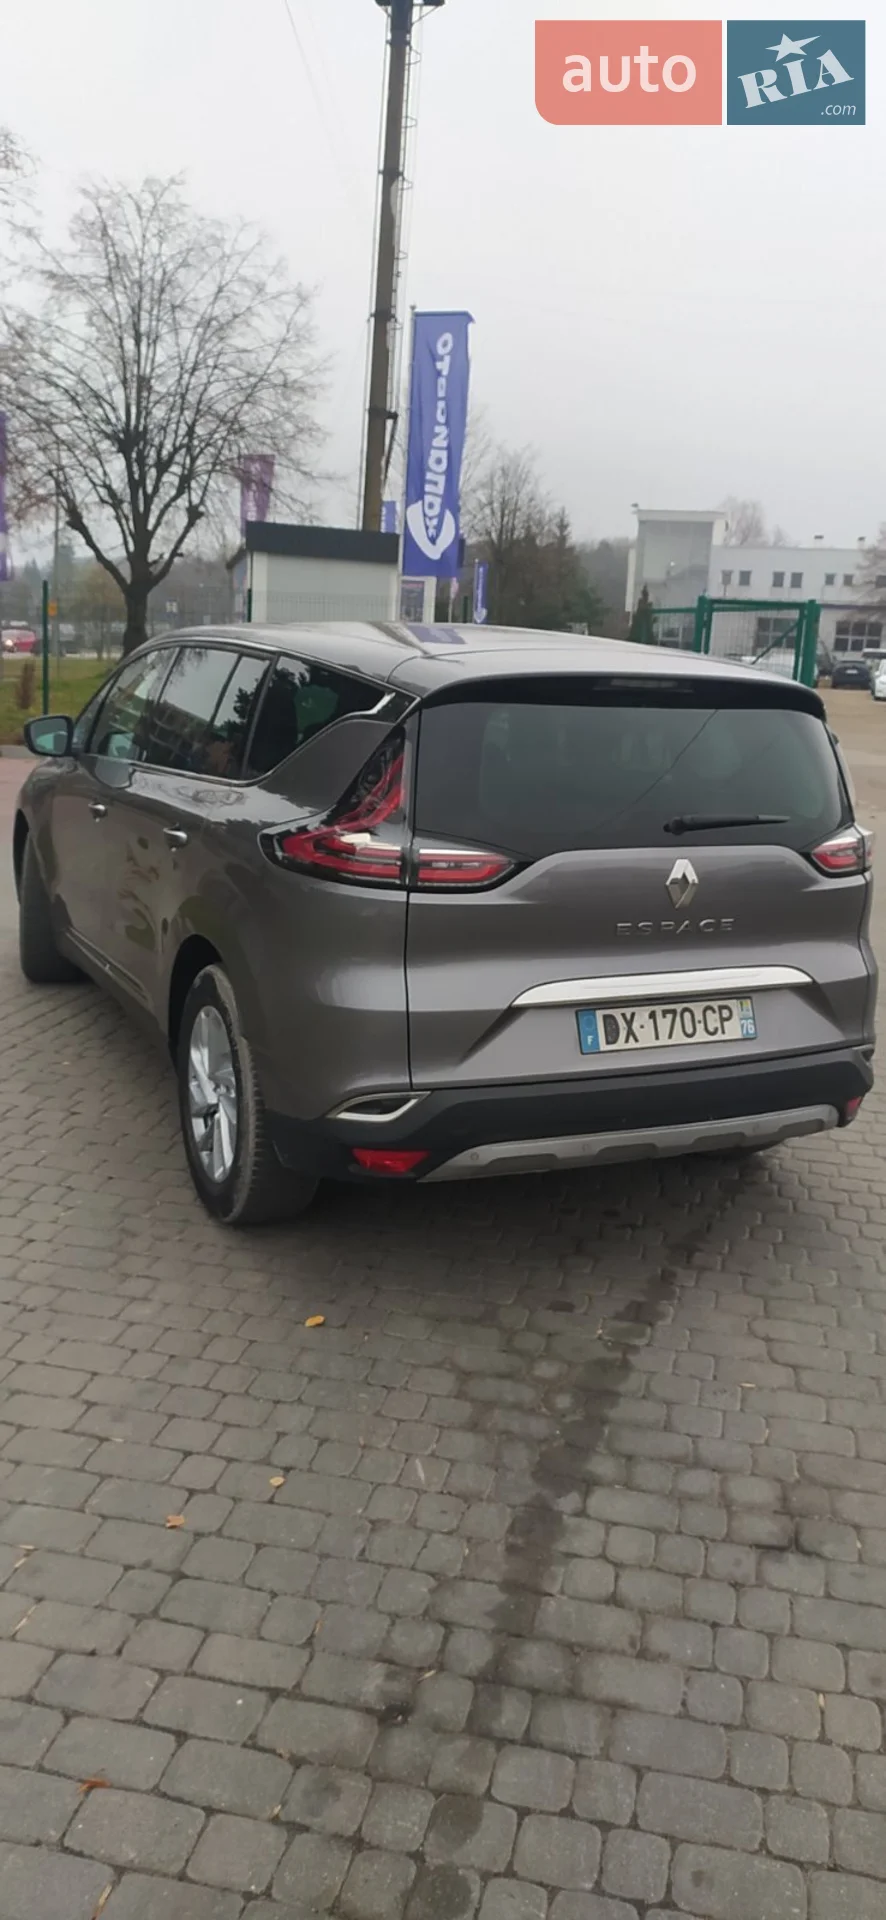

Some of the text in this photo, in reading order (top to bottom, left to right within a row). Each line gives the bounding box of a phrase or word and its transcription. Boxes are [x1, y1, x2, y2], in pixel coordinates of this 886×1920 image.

[616, 918, 735, 935] ESPACE
[741, 1019, 755, 1034] 76
[587, 1035, 595, 1046] F
